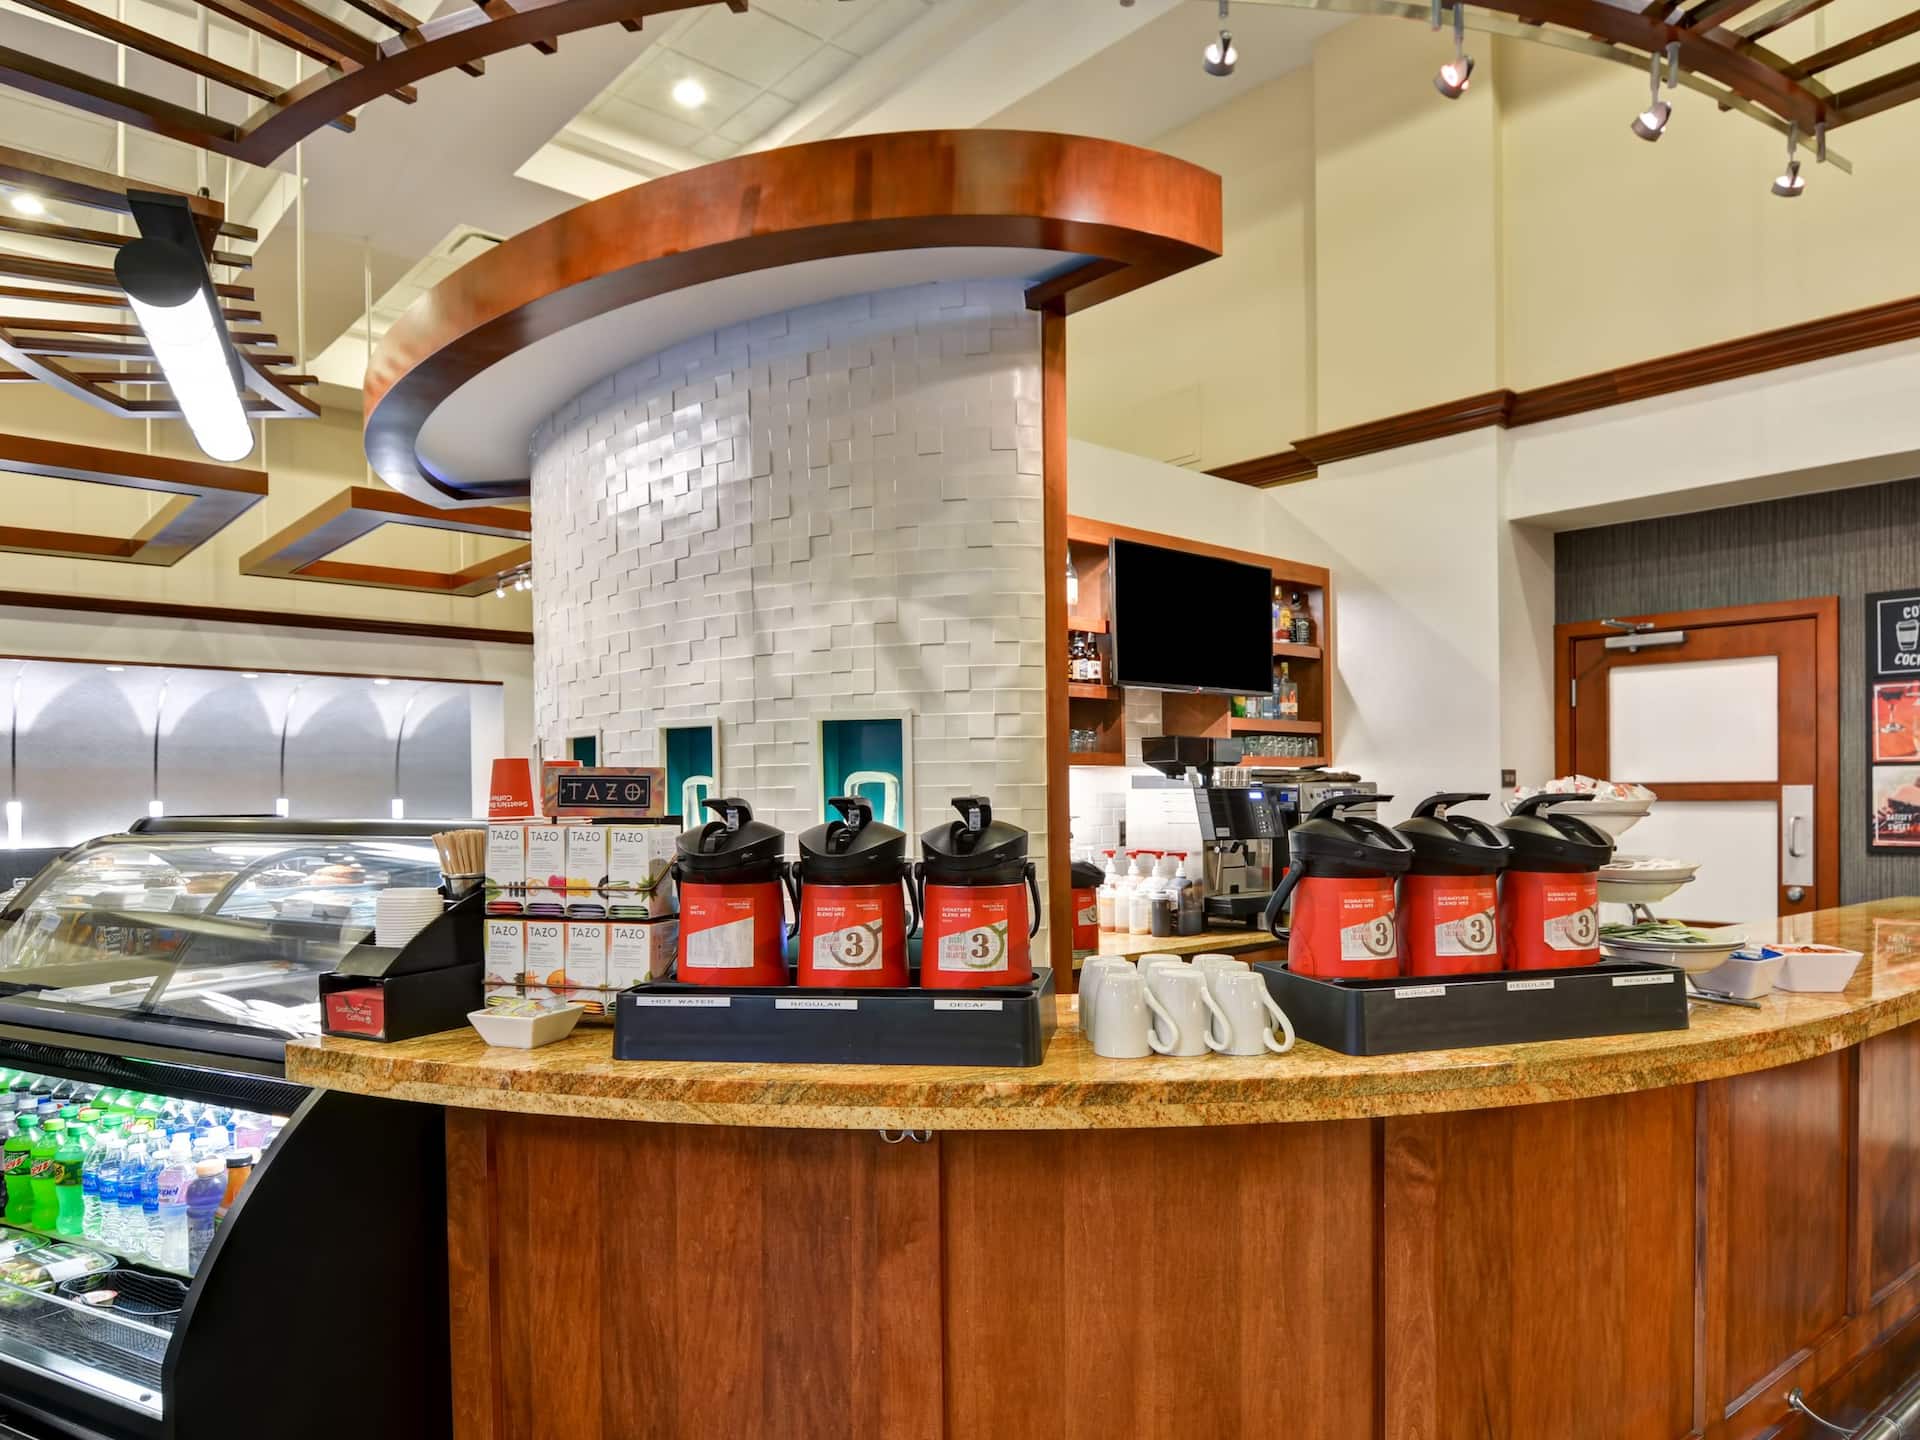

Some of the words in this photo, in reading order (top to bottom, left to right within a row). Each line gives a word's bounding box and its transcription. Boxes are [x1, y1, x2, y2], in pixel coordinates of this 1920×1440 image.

[567, 783, 641, 801] TAZO
[491, 830, 519, 841] TAZO
[530, 831, 559, 842] TAZO
[571, 831, 601, 842] TAZO
[613, 832, 643, 843] TAZO
[490, 926, 518, 936] TAZO
[1471, 919, 1485, 943] 3
[1578, 914, 1590, 938] 3
[529, 927, 558, 938] TAZO
[571, 927, 601, 938] TAZO
[615, 928, 645, 939] TAZO
[1375, 922, 1388, 946] 3
[845, 932, 864, 957] 3
[971, 933, 990, 958] 3
